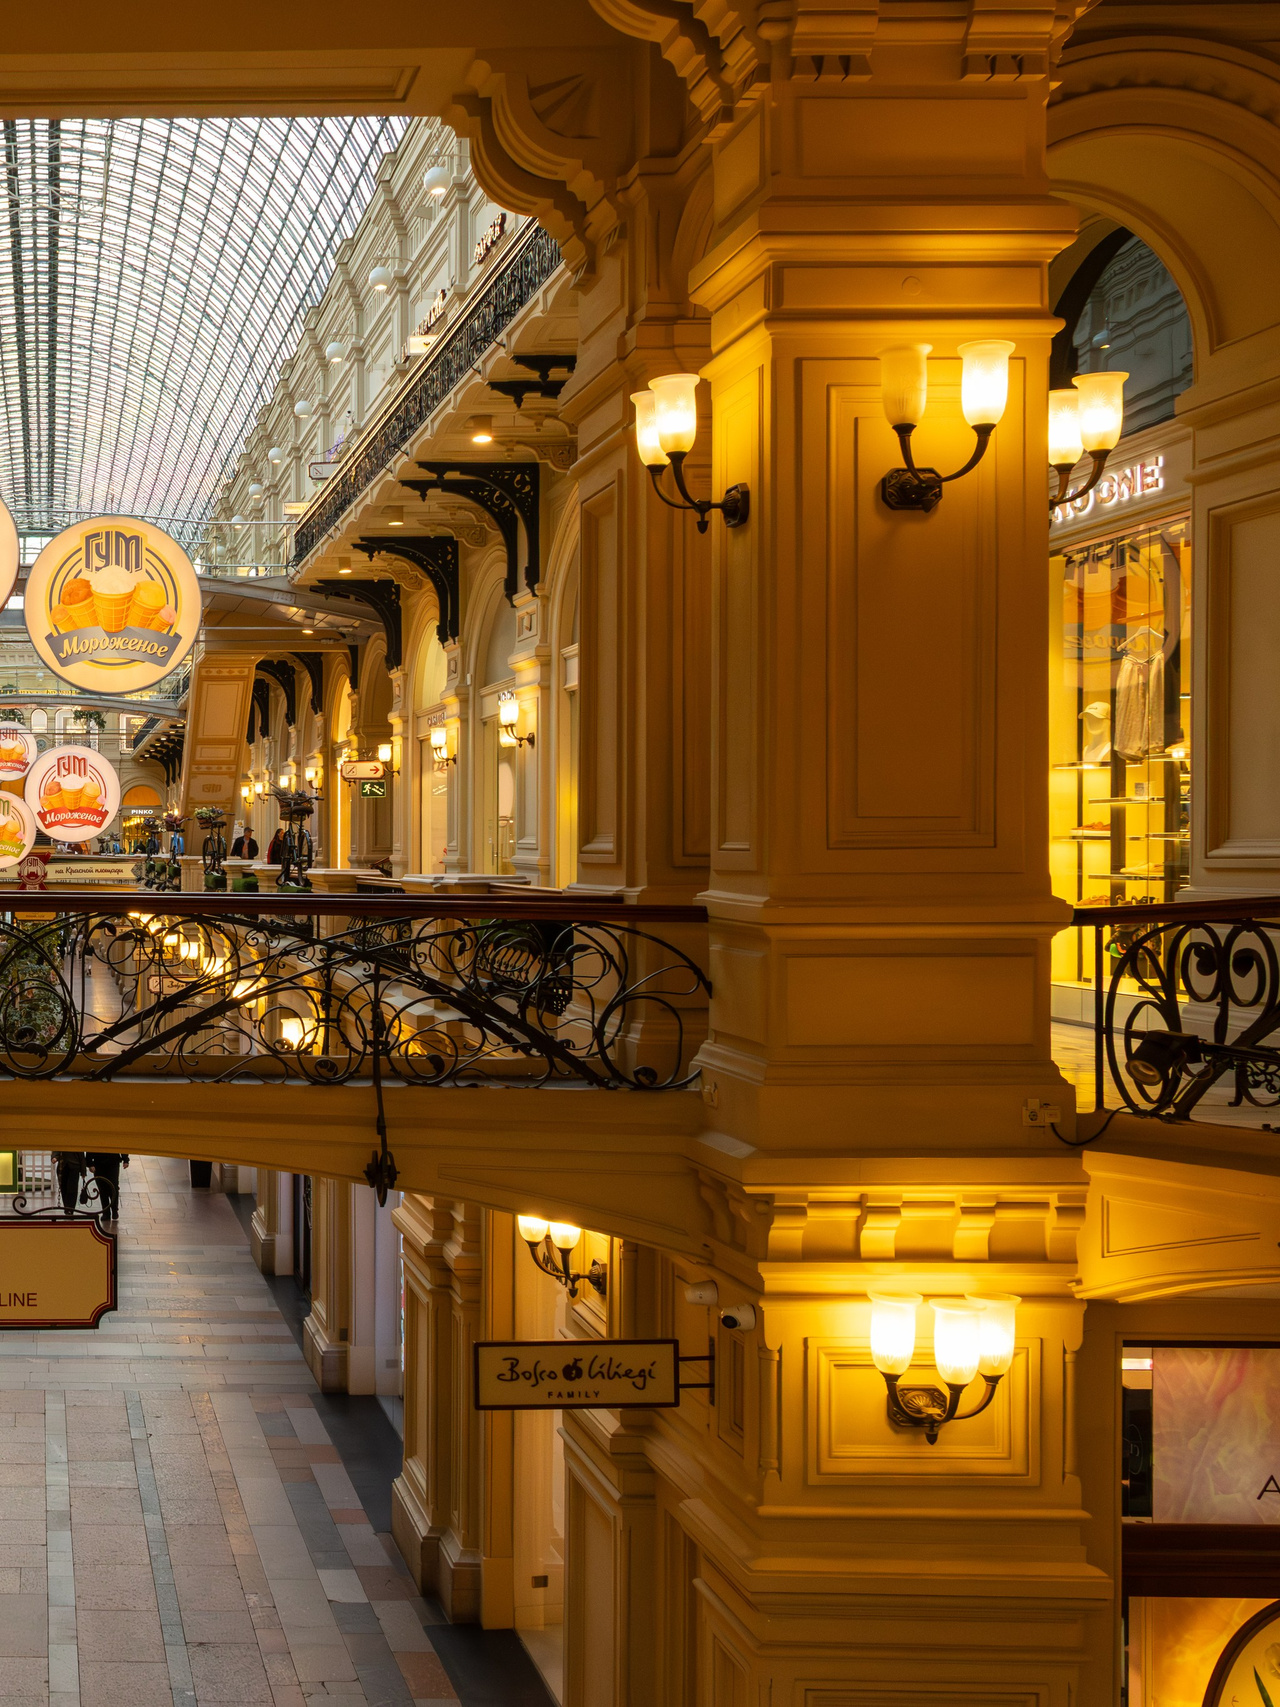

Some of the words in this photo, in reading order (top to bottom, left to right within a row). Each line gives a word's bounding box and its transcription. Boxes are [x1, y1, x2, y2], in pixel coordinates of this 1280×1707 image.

[1095, 455, 1164, 506] ONE
[84, 531, 143, 573] ГУМ
[59, 635, 169, 659] Мороженое
[56, 754, 88, 778] ГУМ
[44, 810, 103, 825] Мороженое
[65, 866, 94, 875] Красной
[95, 867, 124, 875] площади
[497, 1357, 557, 1387] Bosco
[548, 1390, 600, 1399] FAMILY
